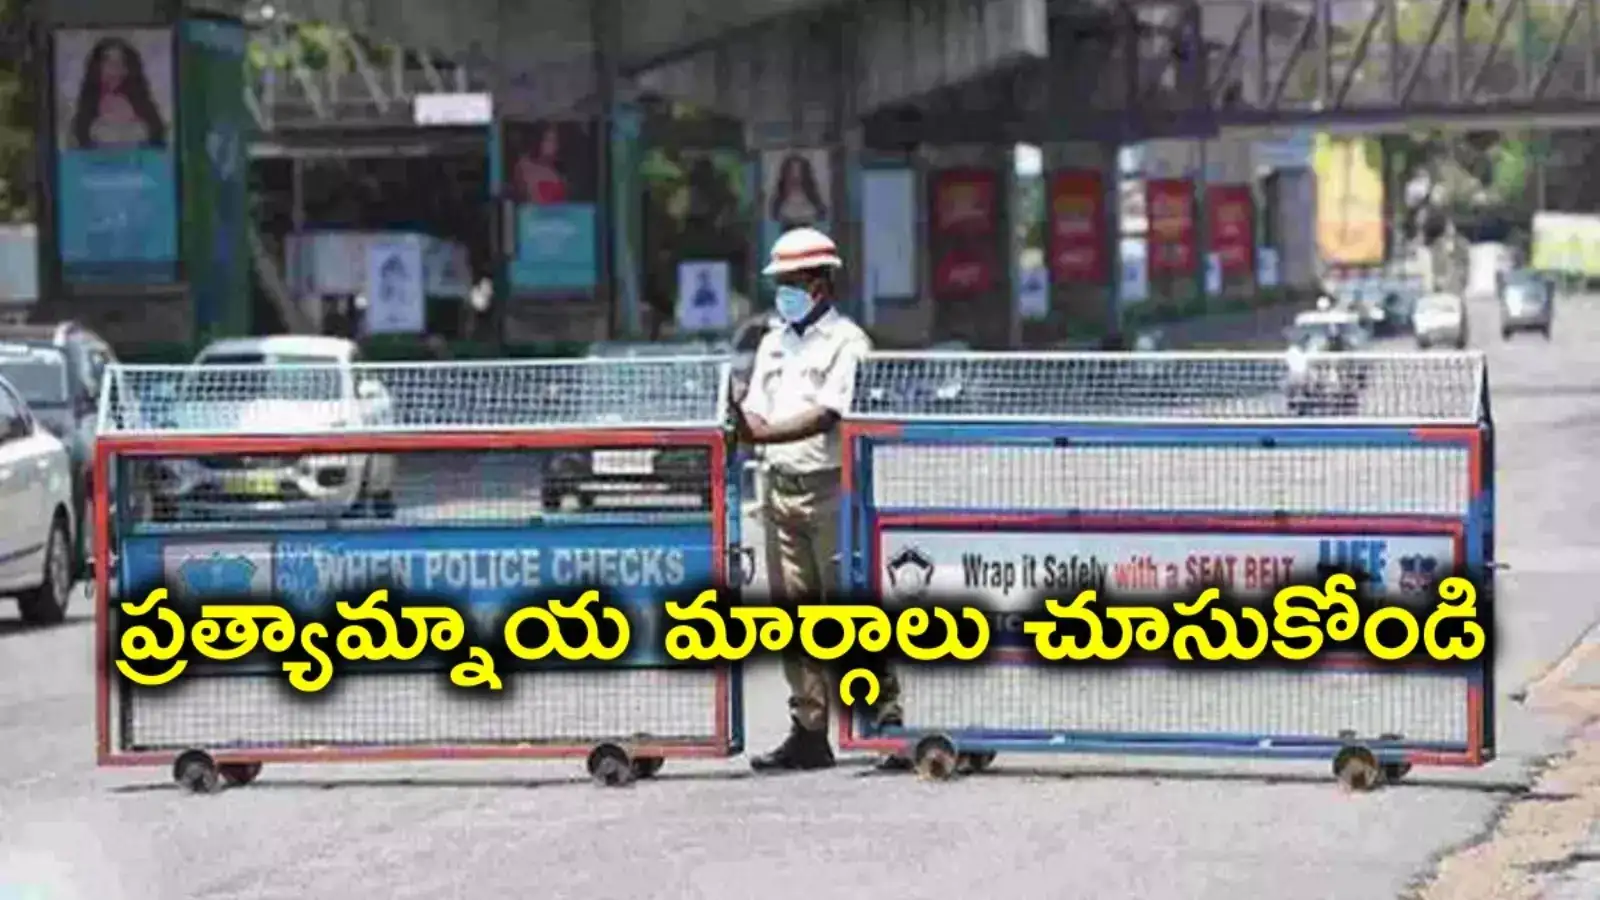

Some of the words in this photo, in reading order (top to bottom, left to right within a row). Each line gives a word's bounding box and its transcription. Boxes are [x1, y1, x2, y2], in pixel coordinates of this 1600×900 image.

[313, 549, 411, 589] WHEN
[424, 548, 541, 588] POLICE
[551, 546, 686, 587] CHECKS
[962, 553, 1015, 595] Wrap
[1022, 554, 1036, 588] it
[1043, 554, 1108, 592] Safely
[1112, 555, 1159, 590] with
[1165, 563, 1179, 589] a
[1184, 555, 1238, 589] SEAT
[1244, 556, 1295, 589] BELT
